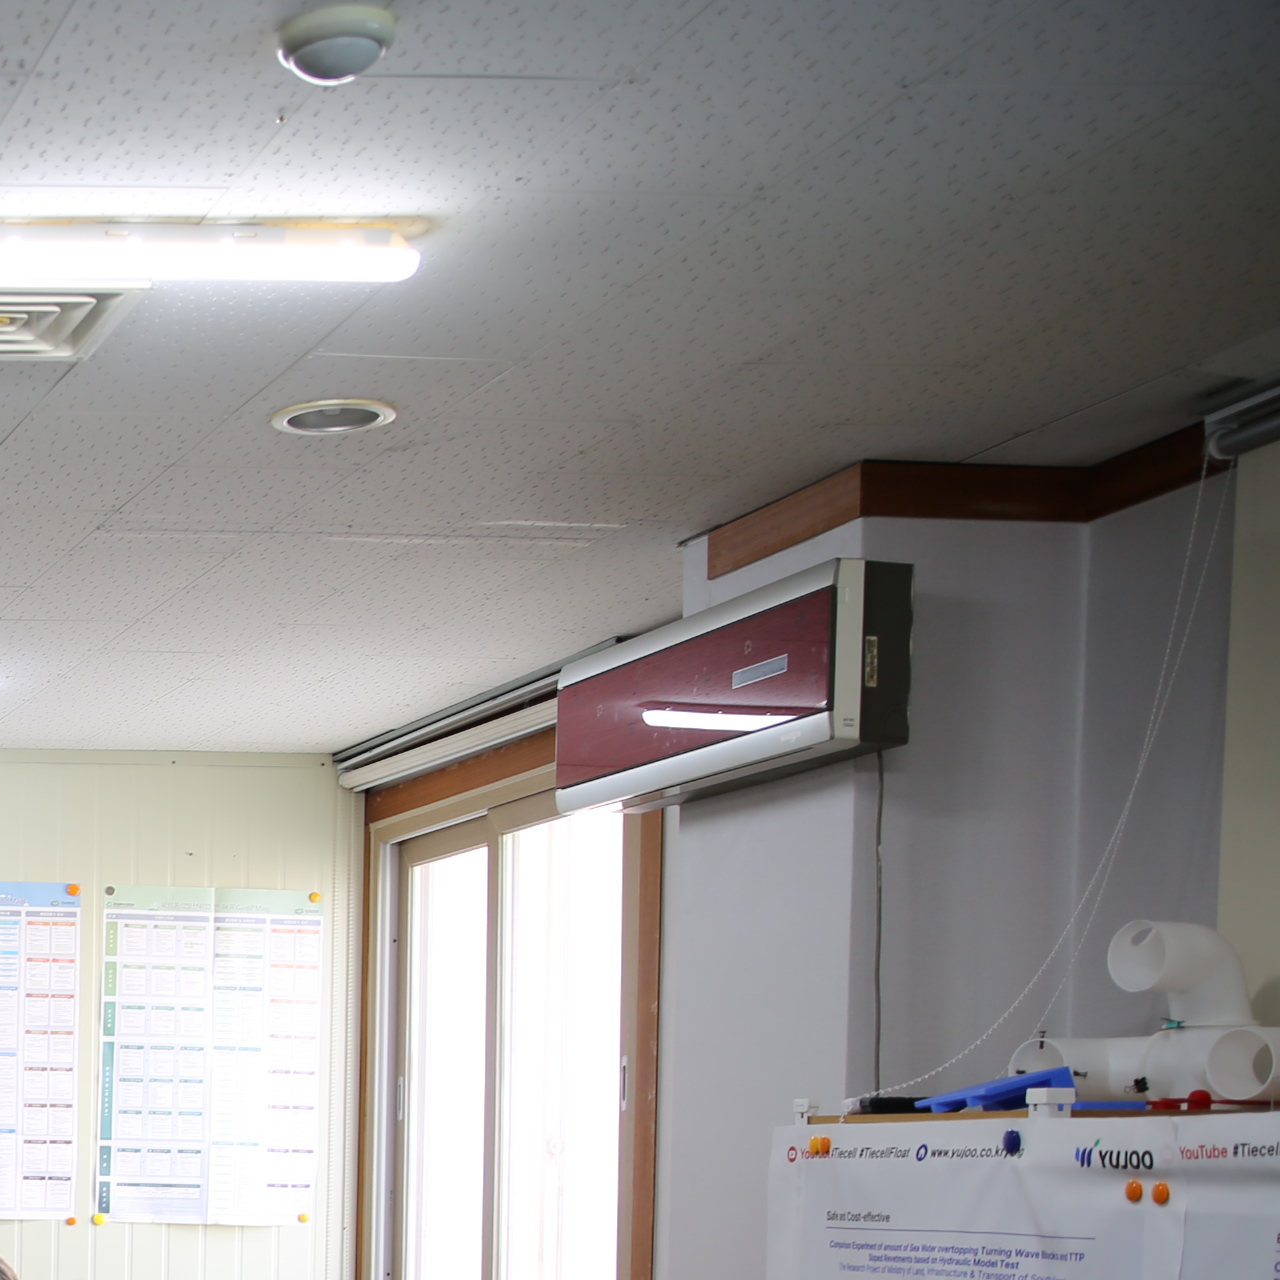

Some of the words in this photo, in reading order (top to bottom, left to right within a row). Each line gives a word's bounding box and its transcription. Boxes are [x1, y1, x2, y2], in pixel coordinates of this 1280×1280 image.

[1099, 1149, 1154, 1169] YUJOO
[1179, 1145, 1228, 1160] YouTube
[937, 1244, 978, 1257] overtopping
[981, 1246, 1012, 1259] Turning
[1015, 1248, 1040, 1259] Wave
[1069, 1252, 1085, 1262] TTP
[939, 1255, 971, 1267] Hydraulic
[973, 1259, 998, 1268] Model
[1000, 1260, 1019, 1269] Test
